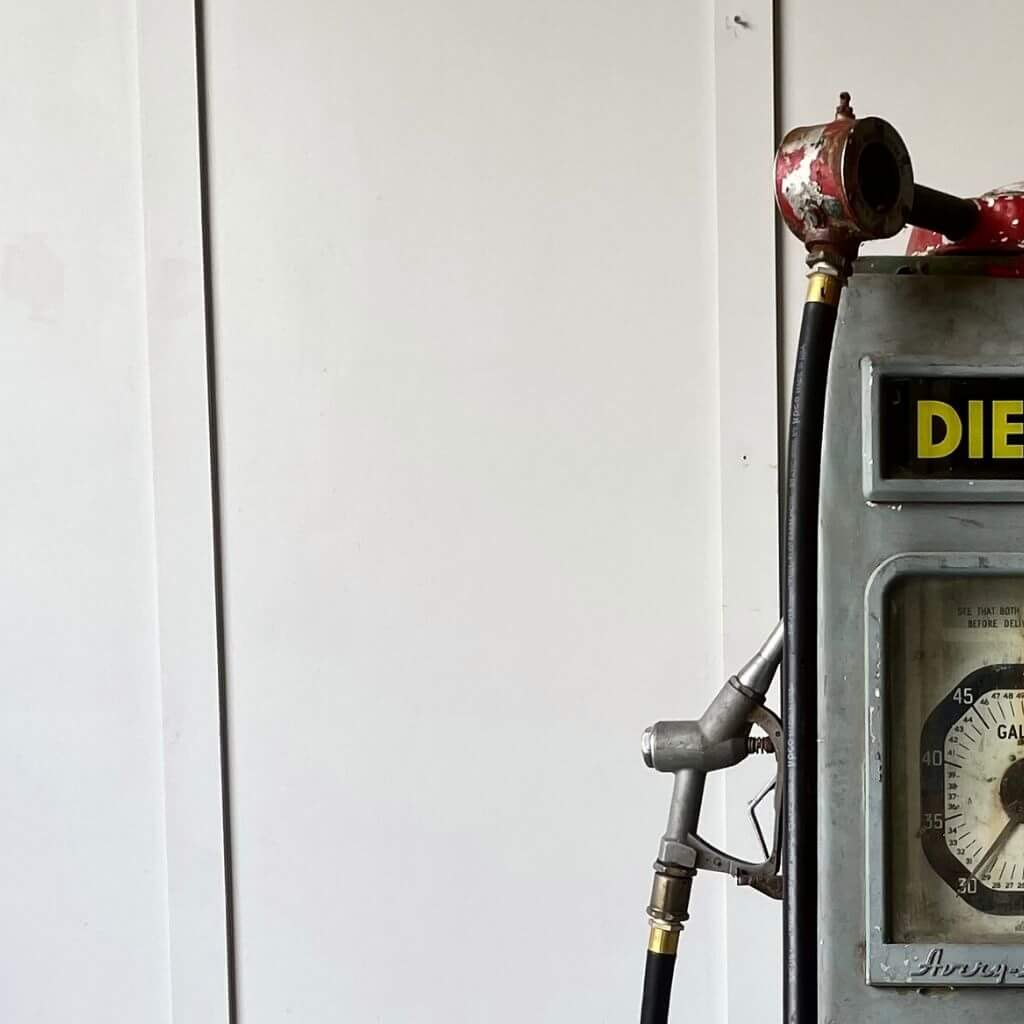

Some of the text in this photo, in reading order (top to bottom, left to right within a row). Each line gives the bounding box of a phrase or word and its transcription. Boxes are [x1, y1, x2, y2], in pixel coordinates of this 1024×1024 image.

[957, 607, 973, 617] SEE
[977, 607, 995, 616] THAT
[1000, 607, 1019, 616] BOTH
[968, 619, 998, 628] BEFORE
[953, 687, 973, 705] 45
[922, 750, 943, 766] 40
[923, 813, 943, 829] 35
[957, 877, 977, 894] 30
